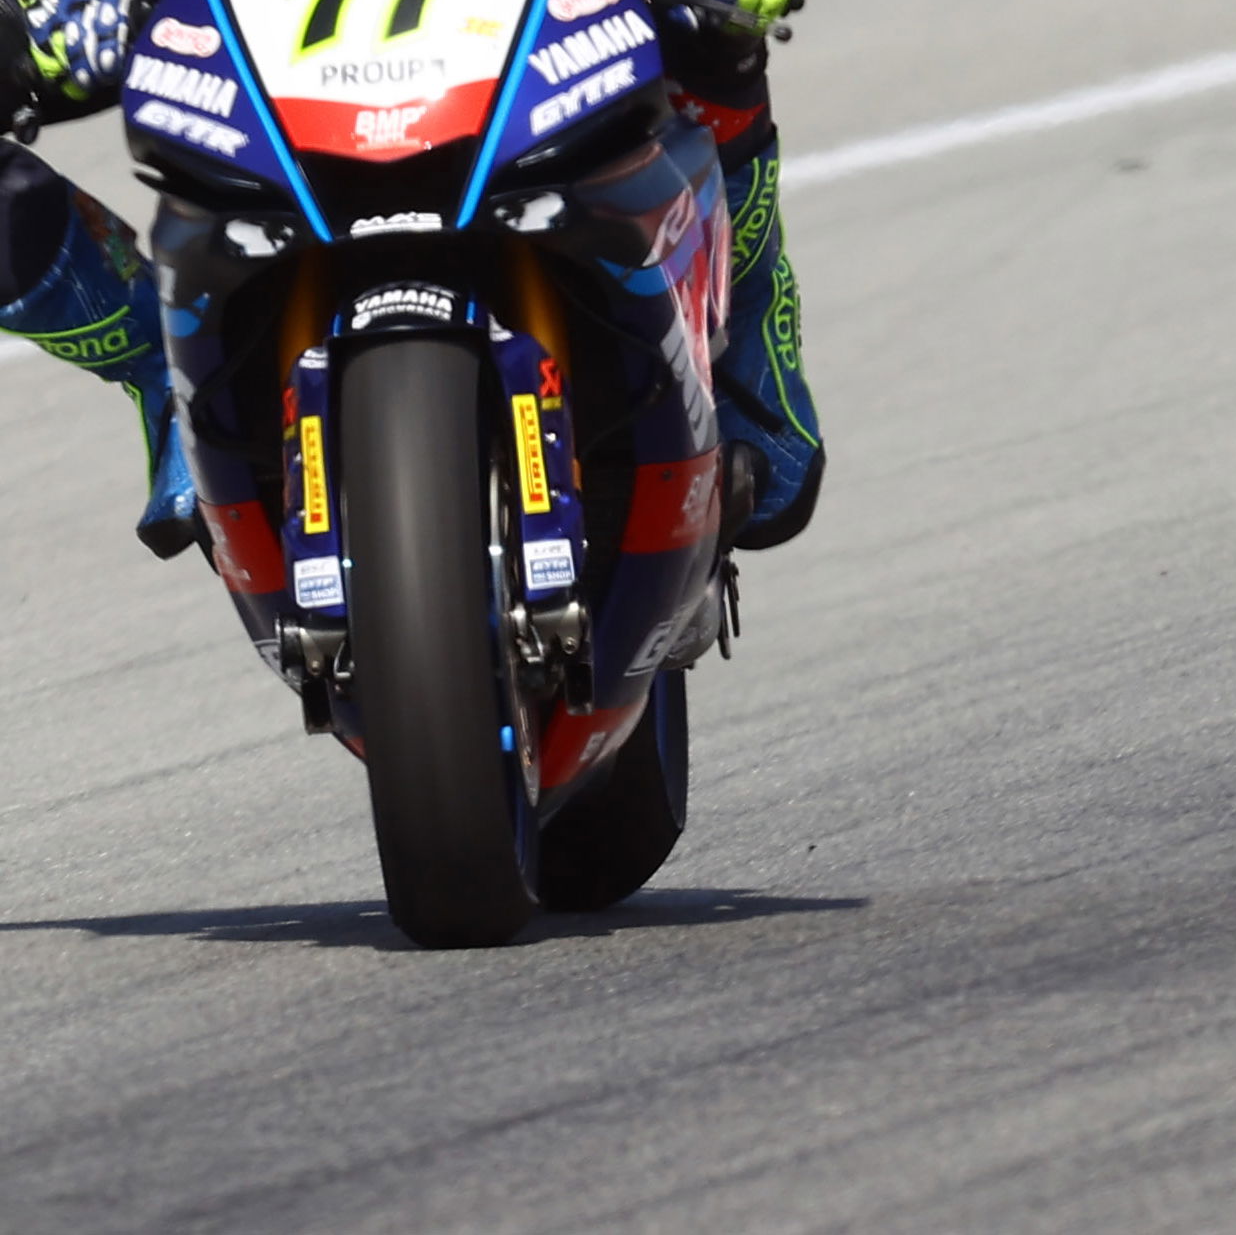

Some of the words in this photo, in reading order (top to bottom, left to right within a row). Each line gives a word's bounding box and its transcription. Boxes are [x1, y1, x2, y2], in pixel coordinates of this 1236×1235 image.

[528, 9, 655, 85] YAMAHA
[126, 54, 238, 118] YAMAHA
[530, 57, 637, 136] GYTR
[133, 99, 249, 158] GYTR
[355, 289, 453, 314] YAMAHA
